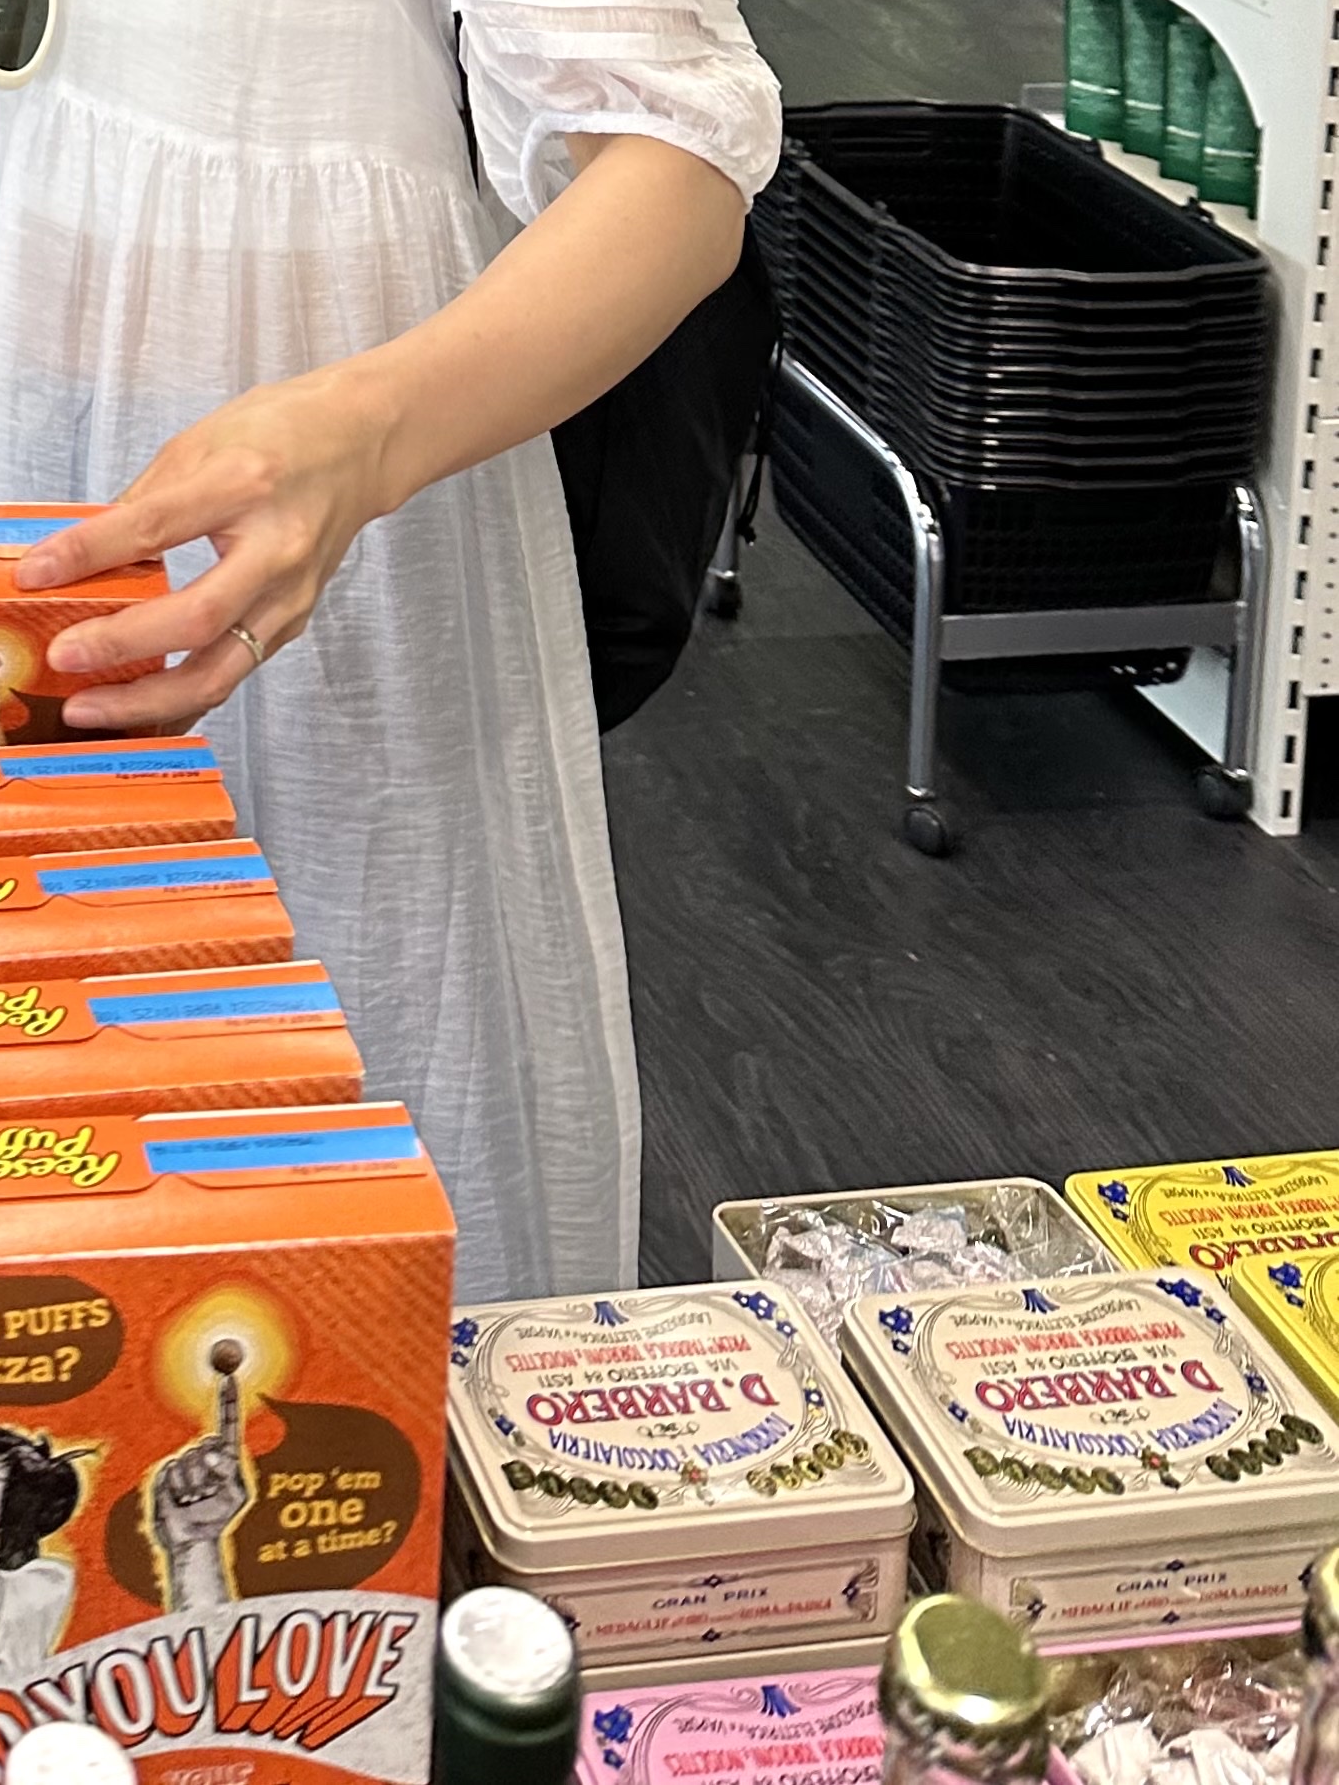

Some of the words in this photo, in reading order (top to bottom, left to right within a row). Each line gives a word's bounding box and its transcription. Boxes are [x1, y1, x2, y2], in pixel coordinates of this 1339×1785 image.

[1192, 1226, 1224, 1239] ASTI
[3, 1297, 111, 1340] PUFFS
[706, 1358, 739, 1372] VIA
[1142, 1343, 1176, 1359] VIA
[538, 1374, 573, 1388] ASTI
[980, 1360, 1017, 1376] ASTI
[1162, 1360, 1223, 1392] D.
[526, 1379, 731, 1426] BARBERO
[721, 1374, 779, 1406] D.
[975, 1365, 1177, 1413] BARBERO
[267, 1472, 325, 1499] pop
[330, 1466, 382, 1491] 'em
[279, 1497, 365, 1529] one
[258, 1539, 288, 1563] at
[292, 1539, 312, 1558] a
[317, 1520, 398, 1554] time?
[651, 1594, 707, 1610] GRAN
[723, 1587, 769, 1602] PRIX
[1117, 1579, 1169, 1594] GRAN
[1184, 1572, 1228, 1586] PRIX
[229, 1612, 419, 1714] LOVE
